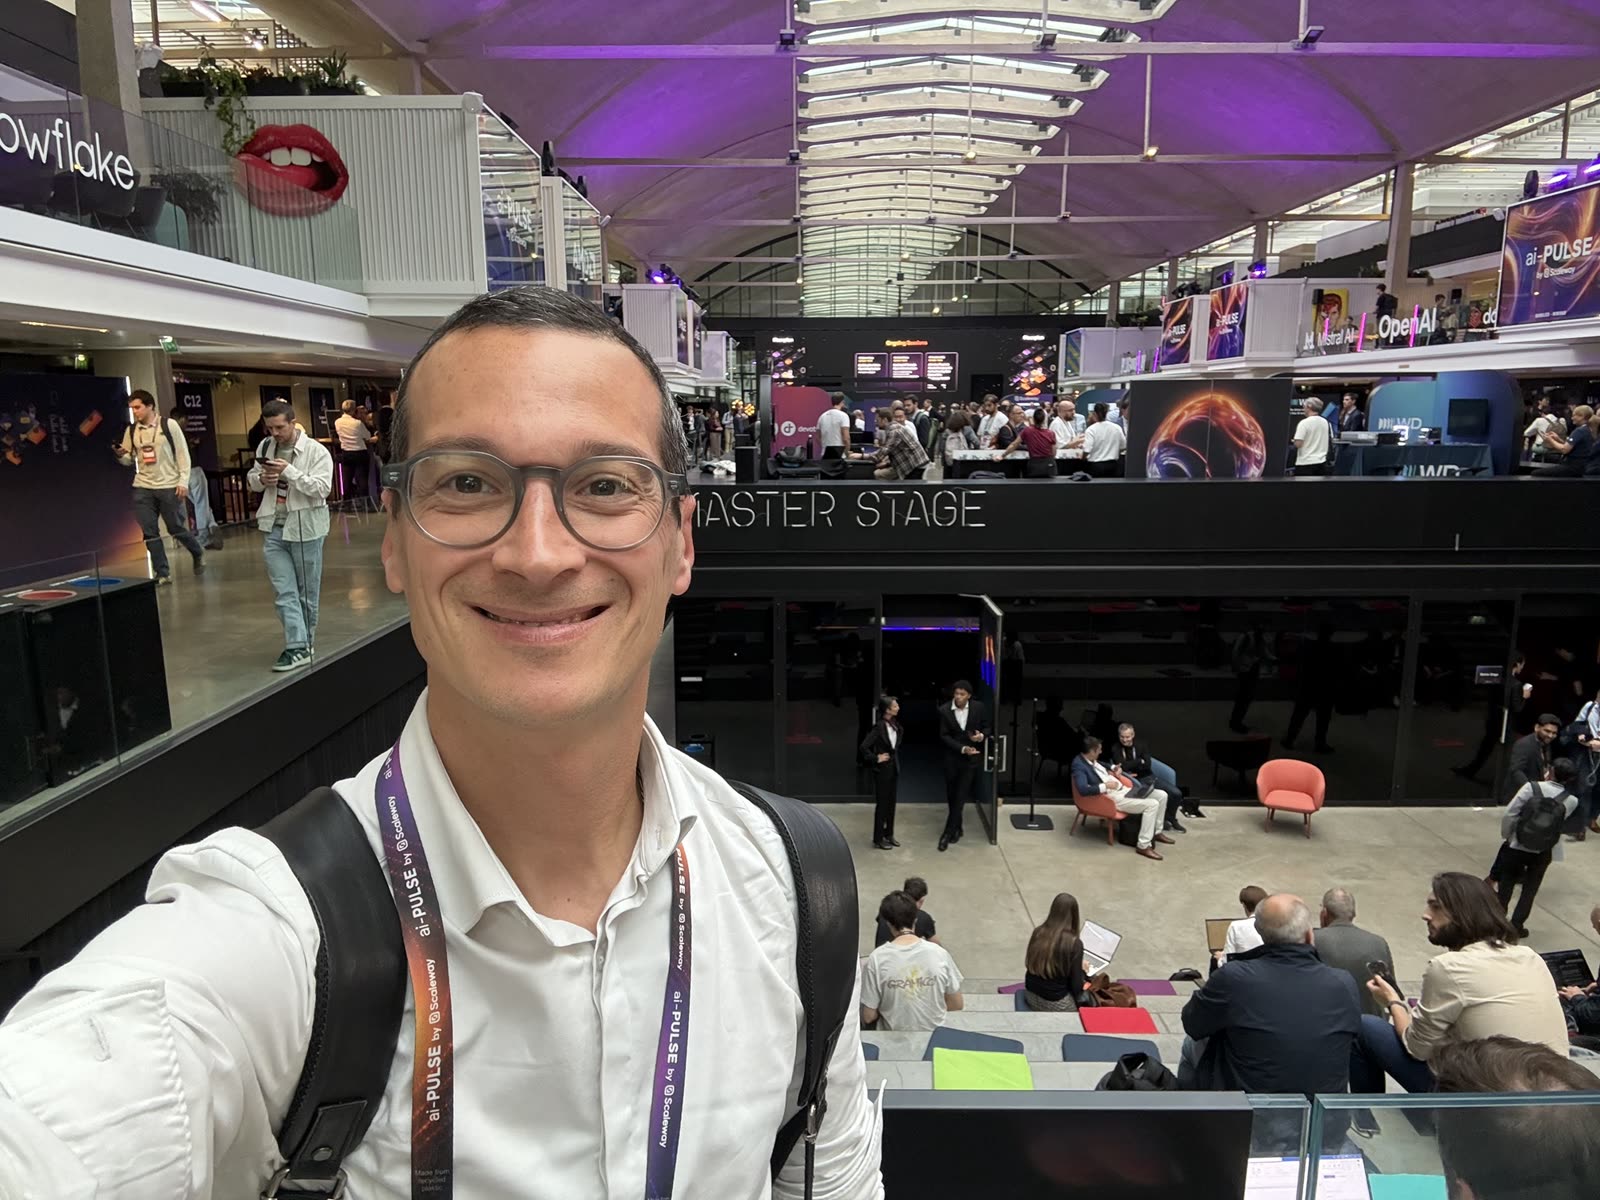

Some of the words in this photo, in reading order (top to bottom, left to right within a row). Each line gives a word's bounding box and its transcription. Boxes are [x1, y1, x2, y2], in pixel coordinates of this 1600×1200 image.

[1525, 236, 1594, 267] ai-PULSE
[1378, 307, 1437, 344] OpenAI
[183, 394, 202, 408] C12
[1396, 417, 1422, 431] WD
[1419, 464, 1461, 477] WD
[693, 491, 833, 528] ASTER
[856, 491, 987, 527] STAGE
[387, 795, 405, 841] Scaleway
[403, 852, 413, 866] by
[403, 867, 431, 937] ai-PULSE
[678, 897, 685, 910] by
[676, 924, 685, 970] Scaleway
[425, 958, 439, 1010] Scaleway
[431, 1027, 442, 1042] by
[667, 990, 682, 1064] ai-PULSE
[426, 1044, 442, 1122] ai-PULSE
[664, 1068, 675, 1081] by
[659, 1097, 673, 1148] Scaleway
